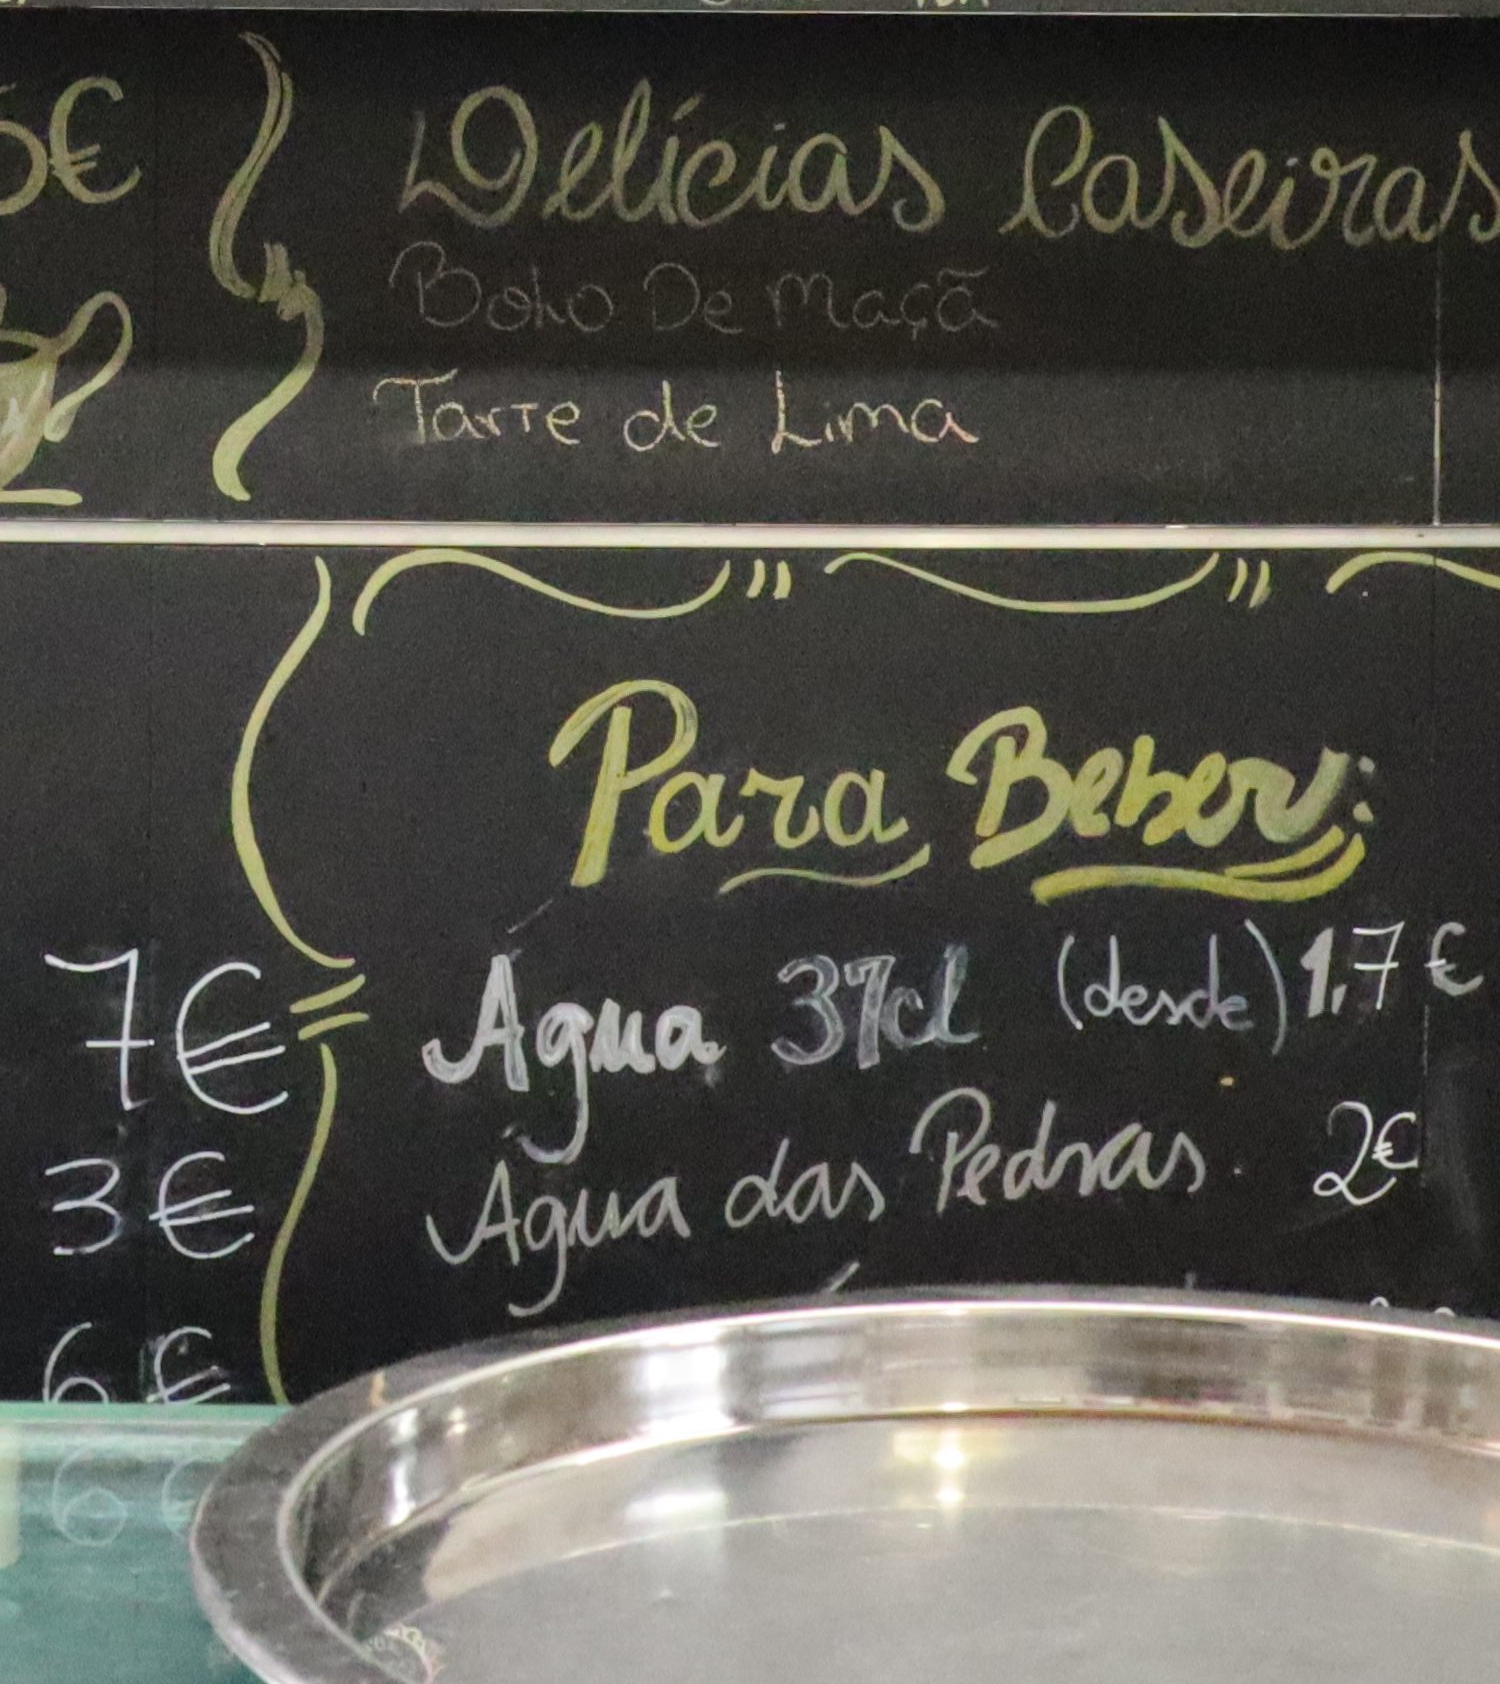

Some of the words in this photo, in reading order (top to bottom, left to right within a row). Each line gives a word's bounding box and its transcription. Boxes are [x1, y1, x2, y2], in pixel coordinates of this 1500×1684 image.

[398, 78, 946, 233] Delícias
[373, 369, 580, 446] Tarte
[623, 381, 720, 452] de
[770, 371, 980, 453] Lima
[548, 679, 908, 888] Para
[45, 948, 290, 1114] 7€
[1056, 918, 1286, 1056] (desde)
[43, 1151, 256, 1260] 3€
[724, 1139, 886, 1229] das
[910, 1088, 1206, 1213] Pedras
[1313, 1100, 1420, 1207] 2€
